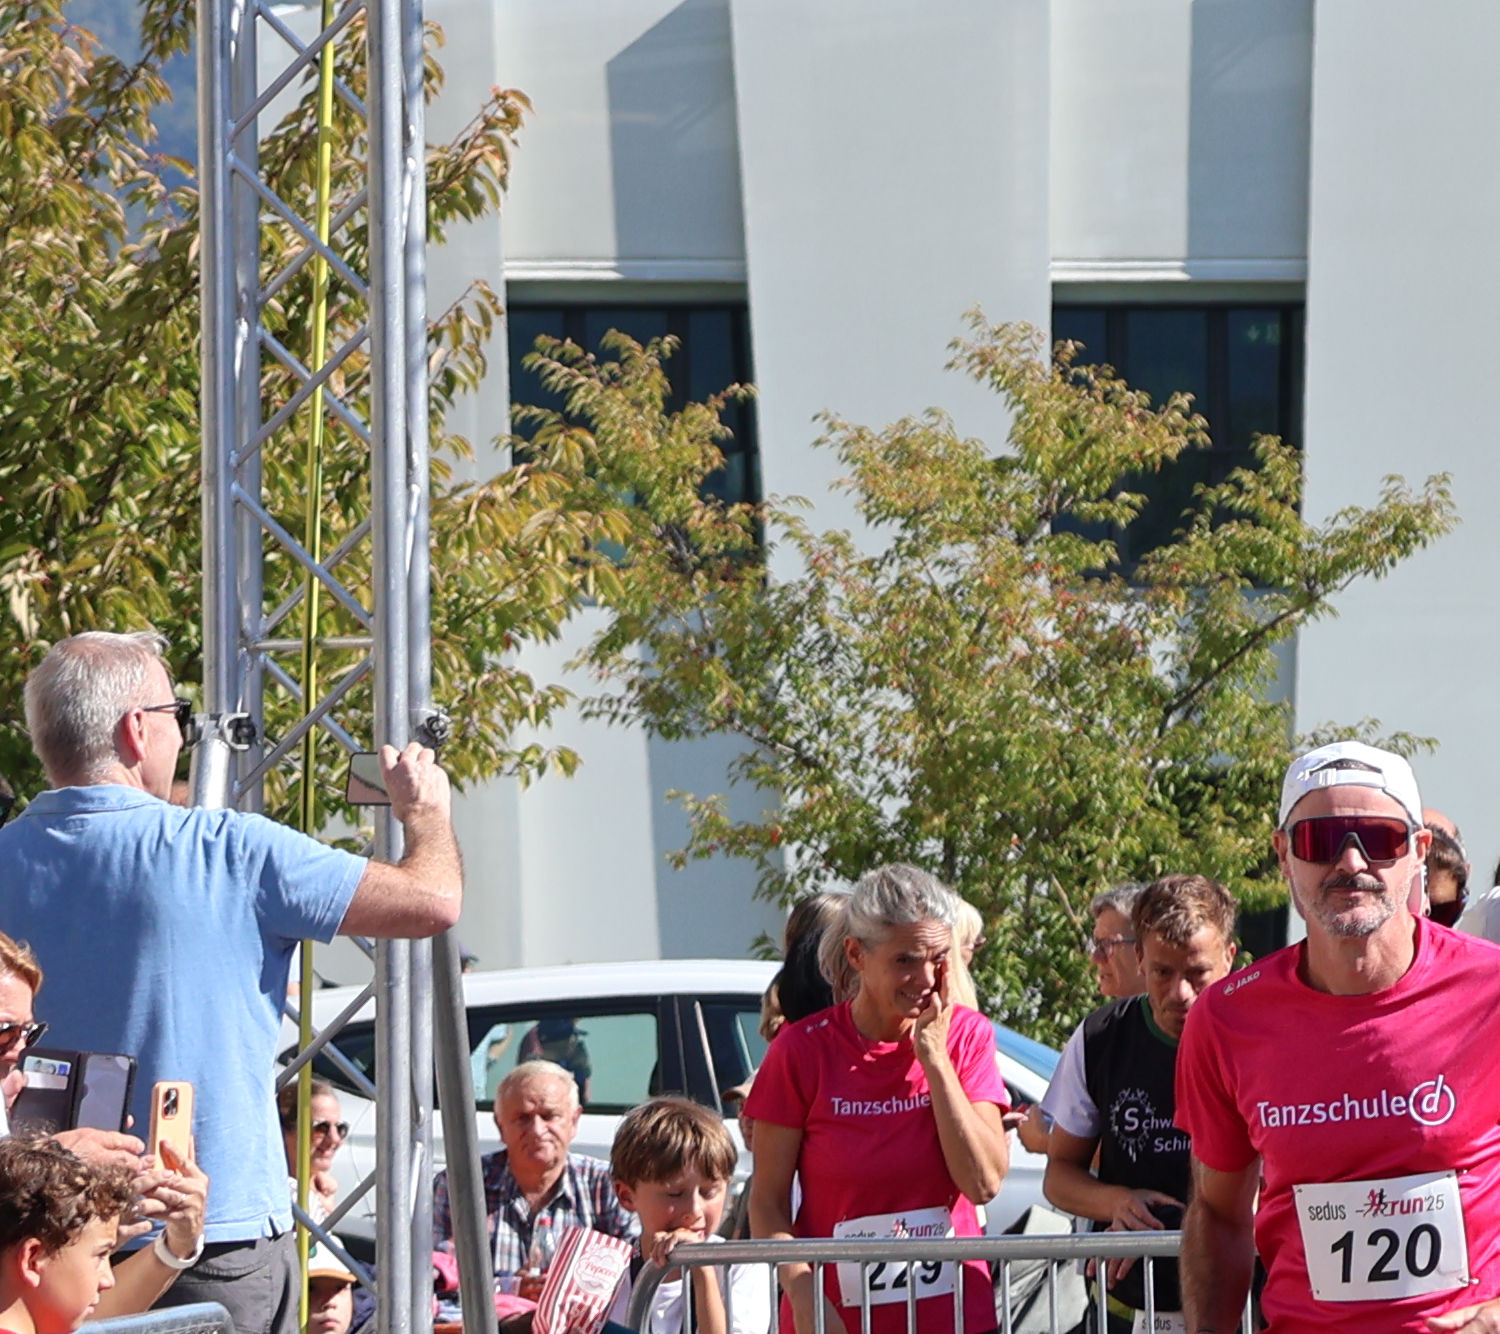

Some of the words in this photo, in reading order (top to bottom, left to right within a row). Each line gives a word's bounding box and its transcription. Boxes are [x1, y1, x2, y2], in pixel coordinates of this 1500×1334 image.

[1236, 970, 1261, 989] JAKO
[831, 1094, 931, 1116] Tanzschule
[1308, 1201, 1346, 1221] sedus
[1330, 1223, 1442, 1283] 120
